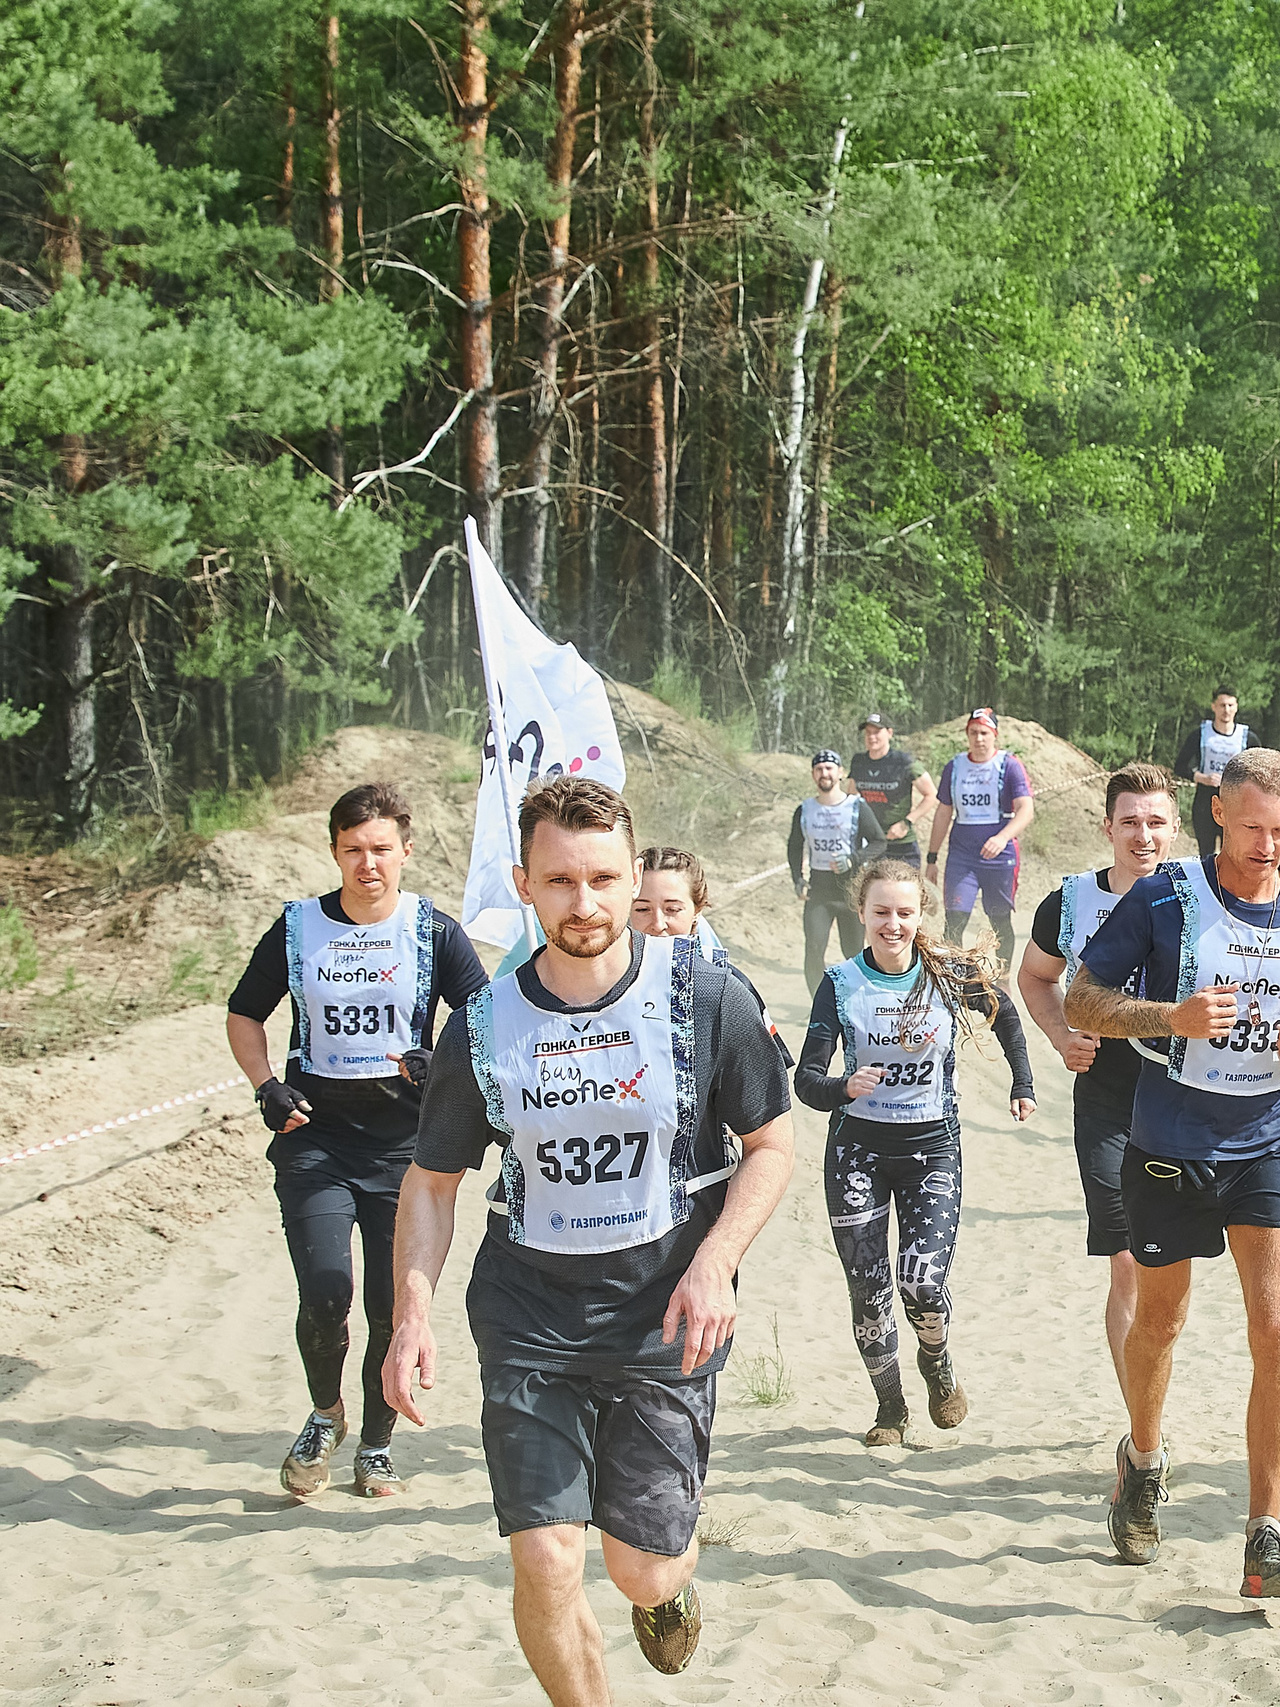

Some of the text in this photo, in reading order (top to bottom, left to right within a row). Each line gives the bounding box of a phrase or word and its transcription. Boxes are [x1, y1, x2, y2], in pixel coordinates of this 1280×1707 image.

[962, 794, 991, 806] 5320
[814, 839, 843, 852] 5325
[329, 940, 392, 948] ГОНКА ГЕРОЕВ
[318, 962, 402, 986] Neoflex
[642, 1002, 665, 1022] 2
[875, 1006, 901, 1014] ГОНКА
[324, 1004, 396, 1036] 5331
[534, 1030, 631, 1055] ГОНКА ГЕРОЕВ
[1224, 1071, 1274, 1082] ГАЗПРОМБАНК
[522, 1063, 650, 1112] Neoflex
[882, 1102, 927, 1110] ГАЗПРОМБАНК
[536, 1131, 650, 1186] 5327
[570, 1209, 649, 1230] ГАЗПРОМБАНК
[864, 1264, 889, 1280] WAY
